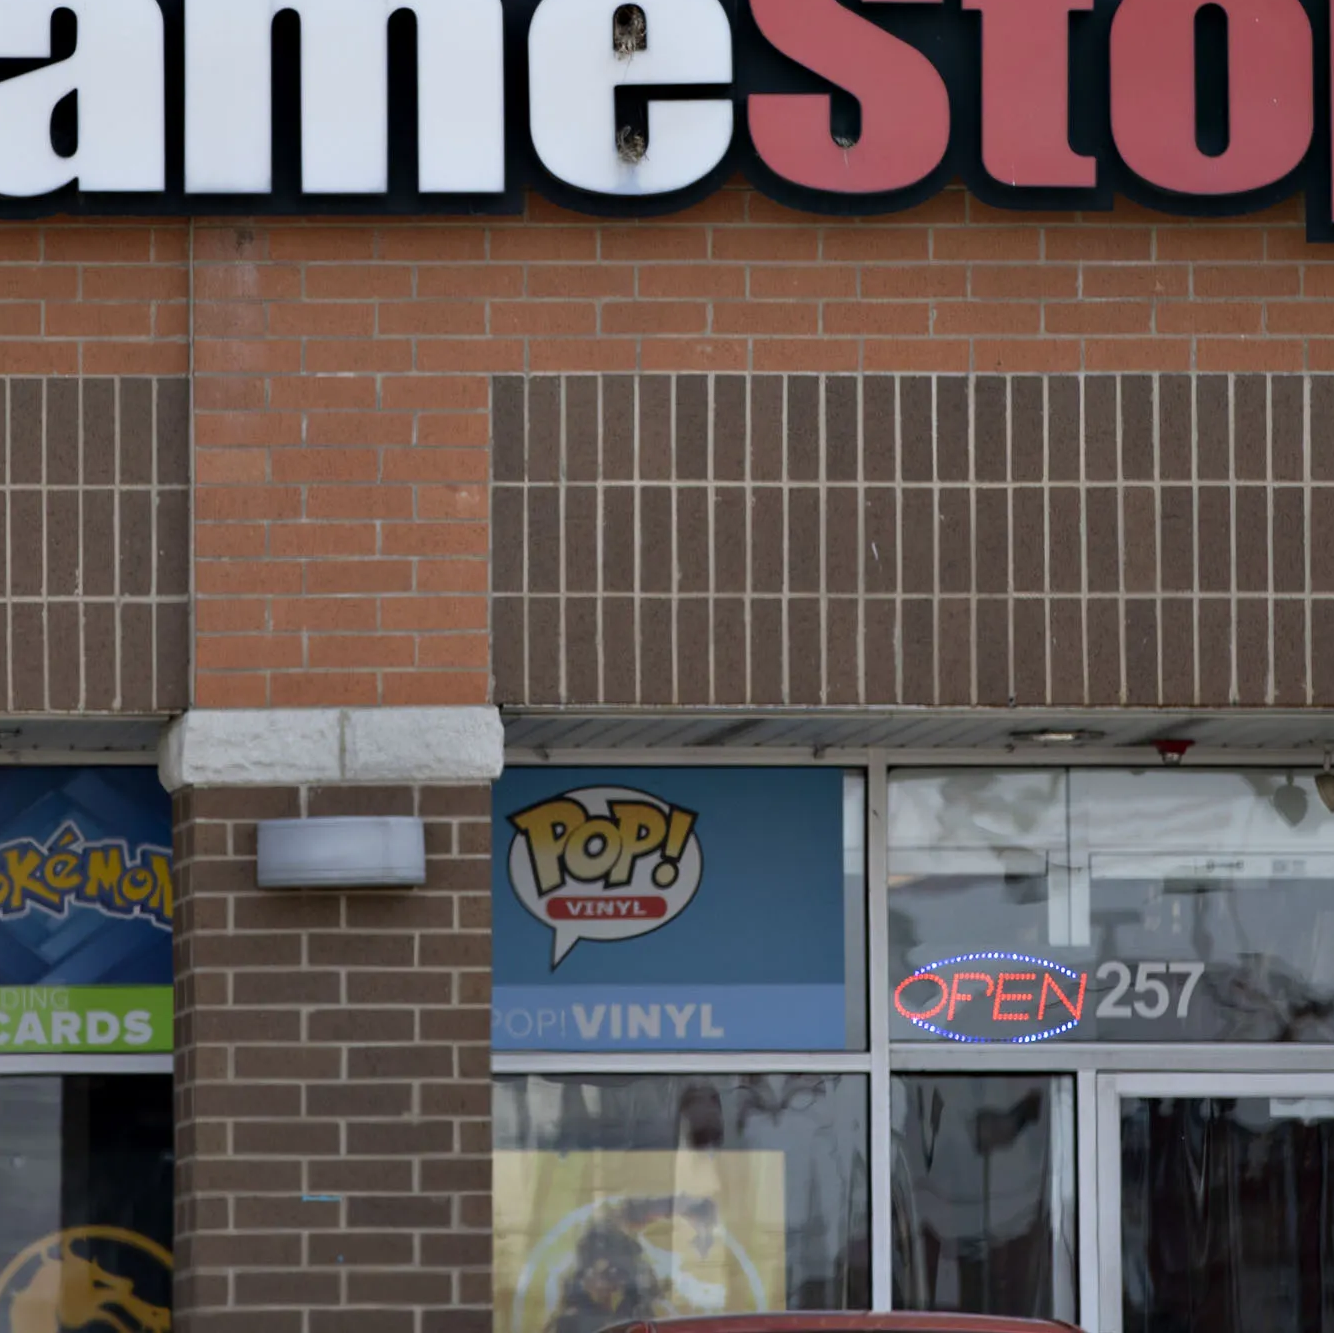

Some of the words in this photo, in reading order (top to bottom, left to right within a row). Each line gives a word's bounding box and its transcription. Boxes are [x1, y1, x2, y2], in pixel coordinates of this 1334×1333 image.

[506, 797, 699, 898] POP!
[566, 900, 647, 916] VINYL
[894, 973, 1087, 1020] OPEN
[1095, 961, 1205, 1018] 257
[571, 1003, 724, 1039] VINYL
